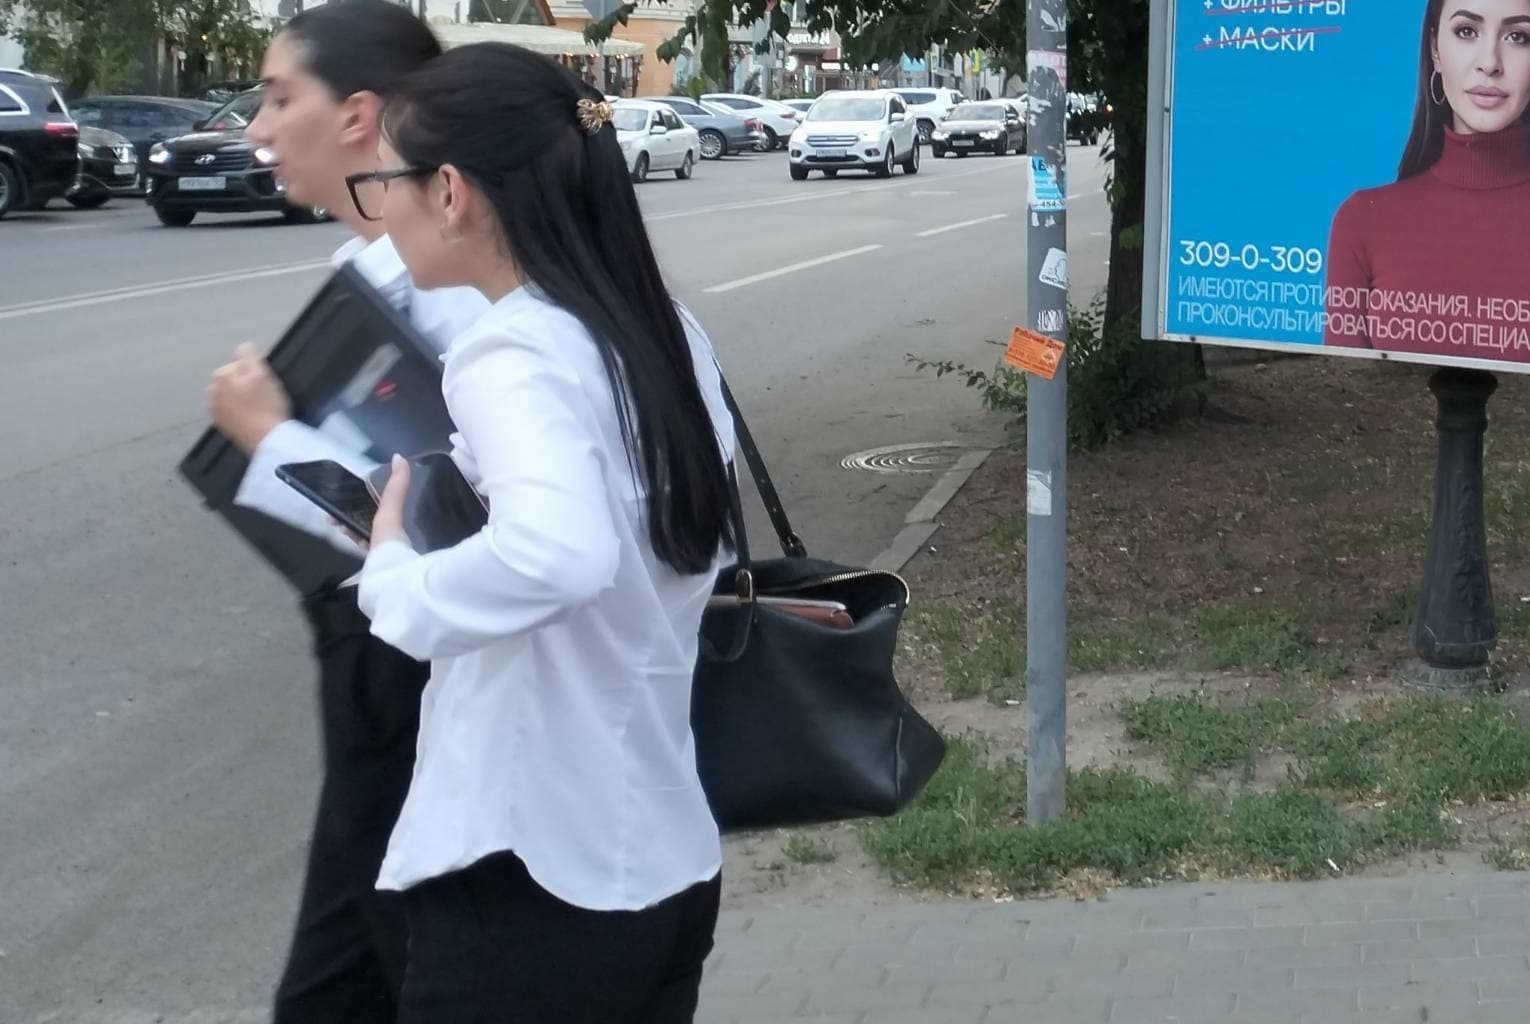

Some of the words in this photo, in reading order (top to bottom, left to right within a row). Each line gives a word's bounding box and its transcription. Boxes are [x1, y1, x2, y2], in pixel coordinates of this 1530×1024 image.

[1219, 26, 1315, 52] МАСКИ
[1179, 240, 1323, 274] 309-0-309
[1178, 276, 1270, 302] ИМЕЮТСЯ
[1271, 279, 1474, 318] ПРОТИВОПОКАЗАНИЯ.
[1177, 302, 1416, 341] ПРОКОНСУЛЬТИРОВАТЬСЯ
[1417, 320, 1448, 344] СО
